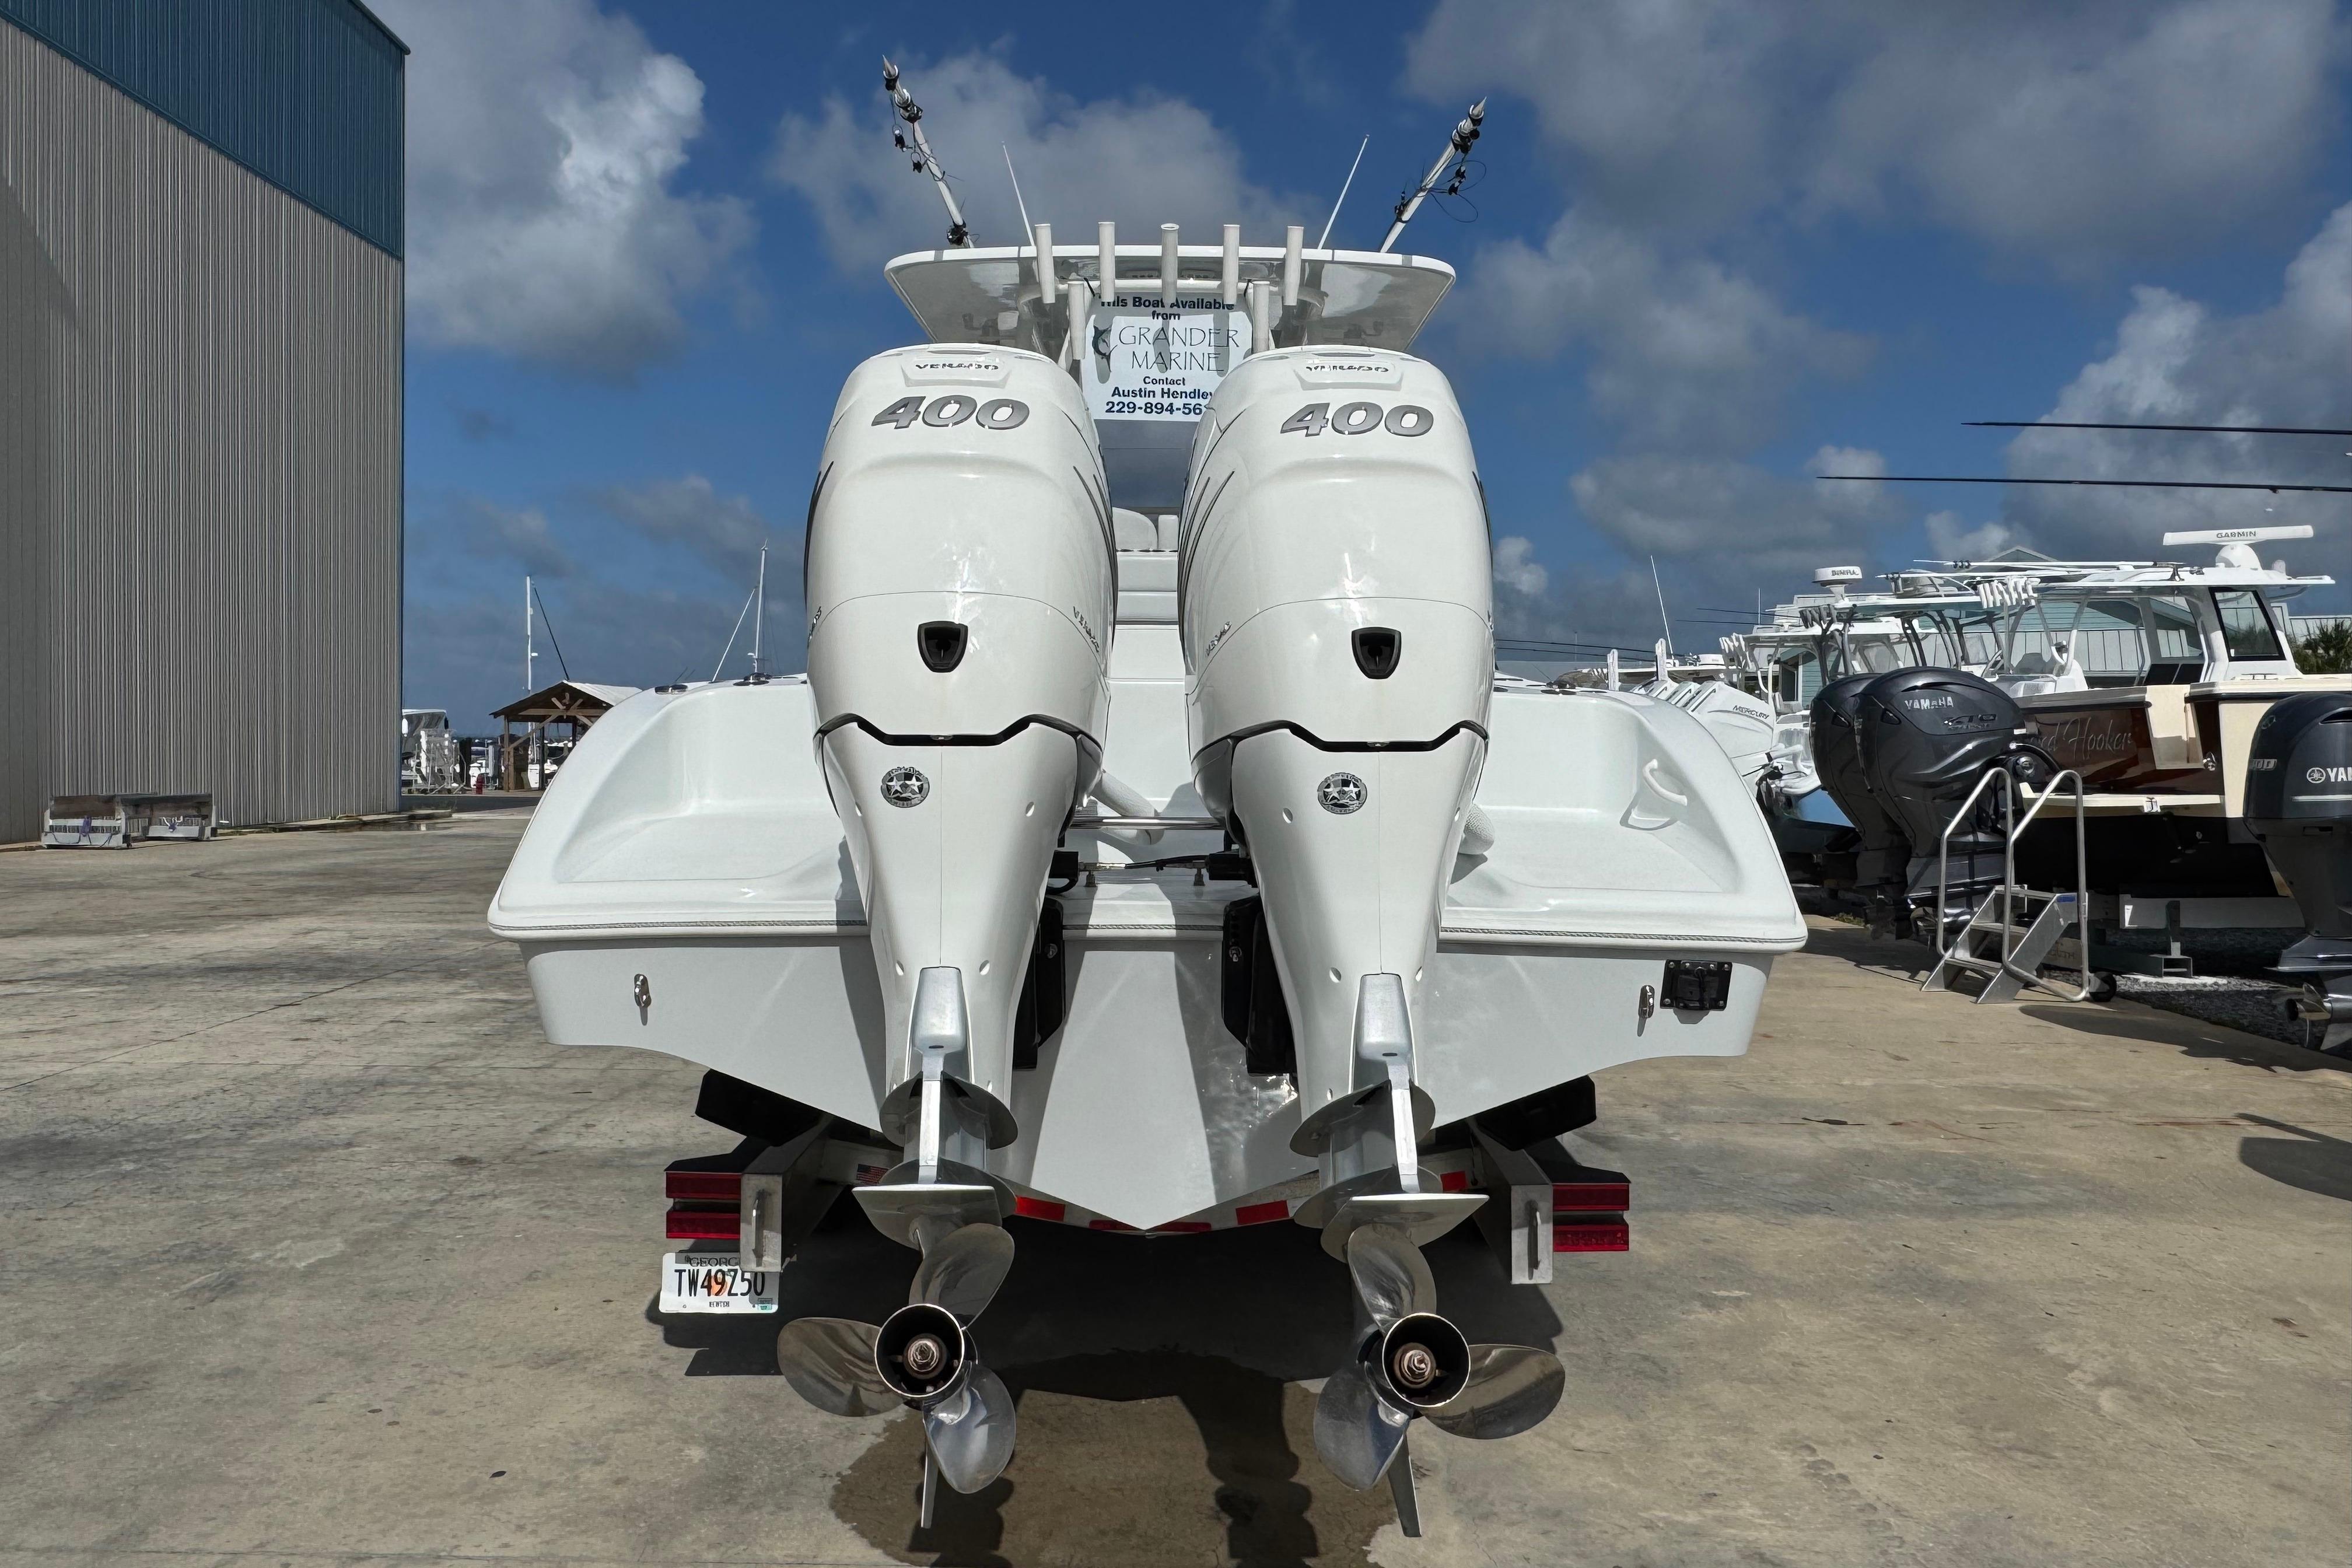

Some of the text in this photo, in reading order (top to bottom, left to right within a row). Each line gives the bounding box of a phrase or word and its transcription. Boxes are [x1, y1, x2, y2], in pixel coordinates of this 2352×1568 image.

[1152, 310, 1181, 320] from
[1119, 326, 1240, 348] GRANDER
[1132, 351, 1224, 372] MARINE
[1143, 376, 1186, 386] Contact
[1111, 386, 1156, 398] Austin
[871, 395, 1030, 430] 400
[1105, 401, 1203, 415] 229-894-56
[1280, 402, 1434, 437] 400
[1904, 696, 1954, 710] YAMAHA
[689, 1256, 740, 1266] GEORG
